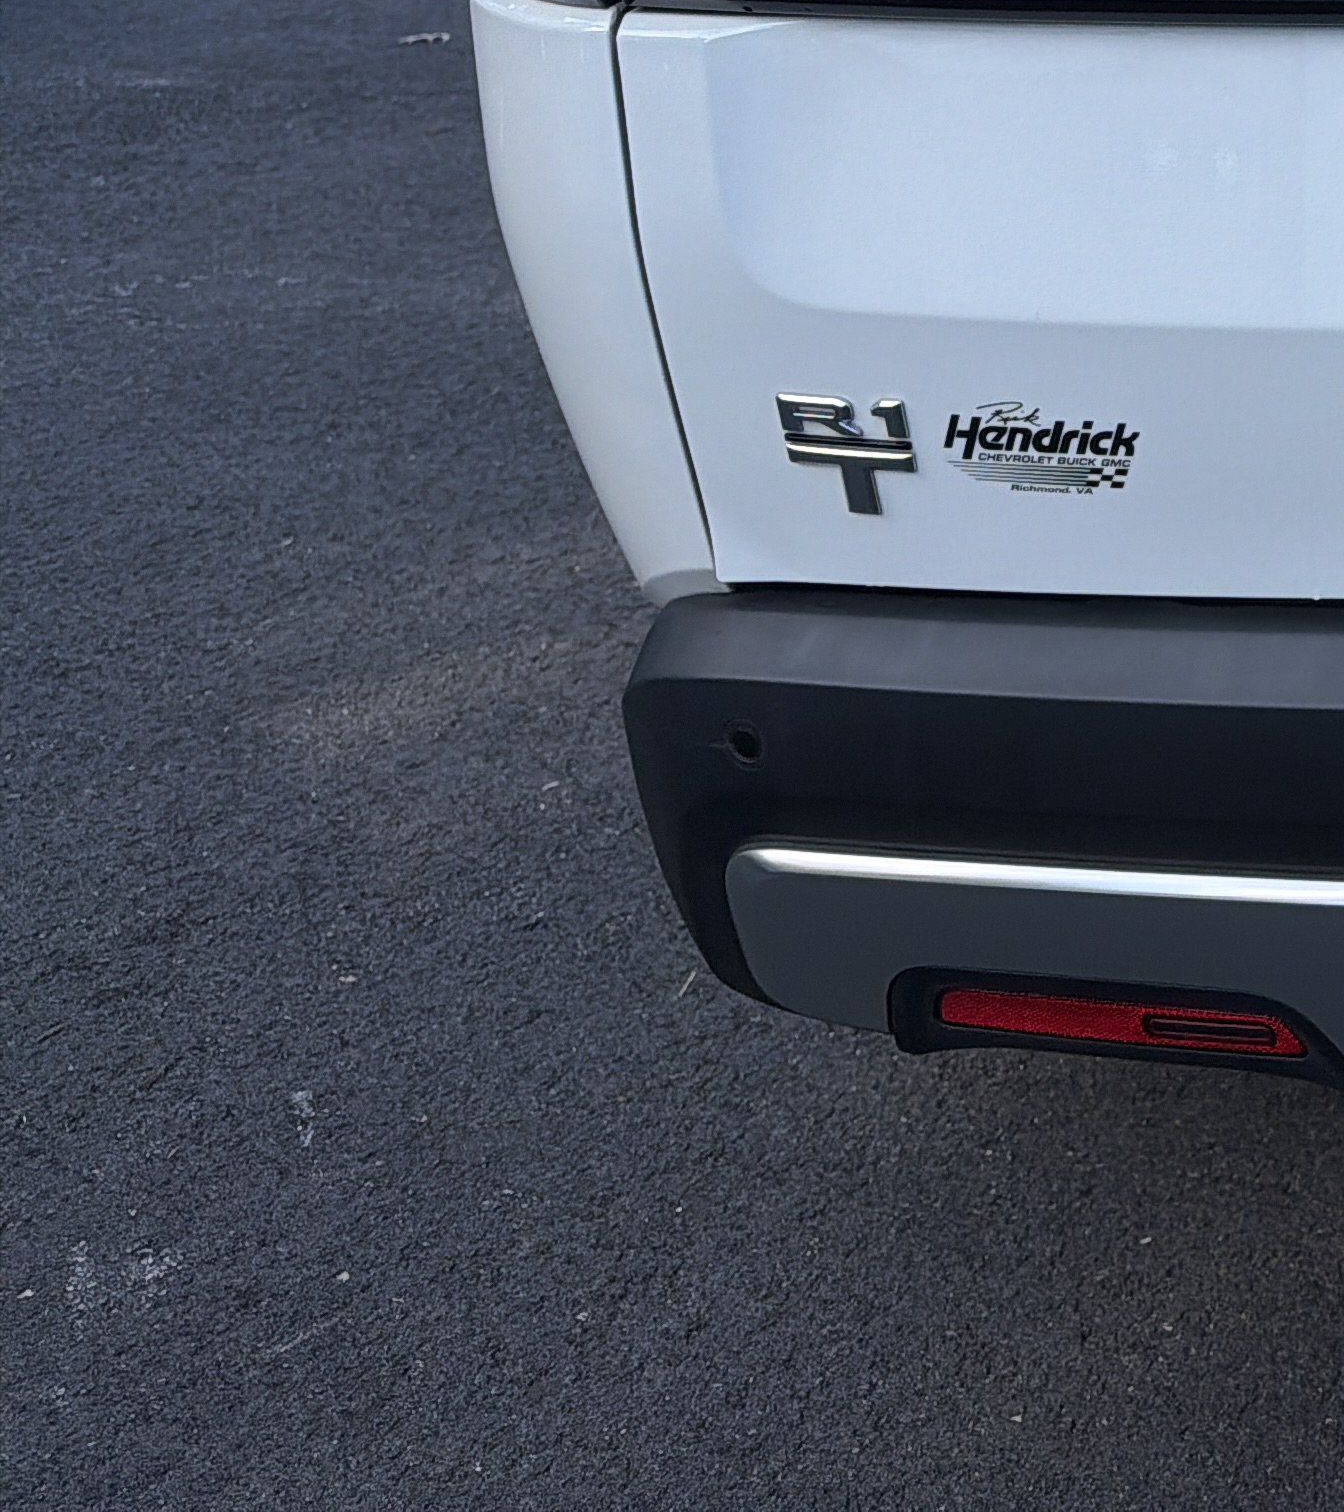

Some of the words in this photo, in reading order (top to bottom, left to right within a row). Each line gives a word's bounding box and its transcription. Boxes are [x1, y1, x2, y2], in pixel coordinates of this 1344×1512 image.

[943, 414, 1140, 460] Hendrick
[978, 452, 1054, 464] CHEVROLET
[1057, 456, 1096, 466] BUICK
[1101, 458, 1131, 468] GMC
[1076, 487, 1094, 495] VA
